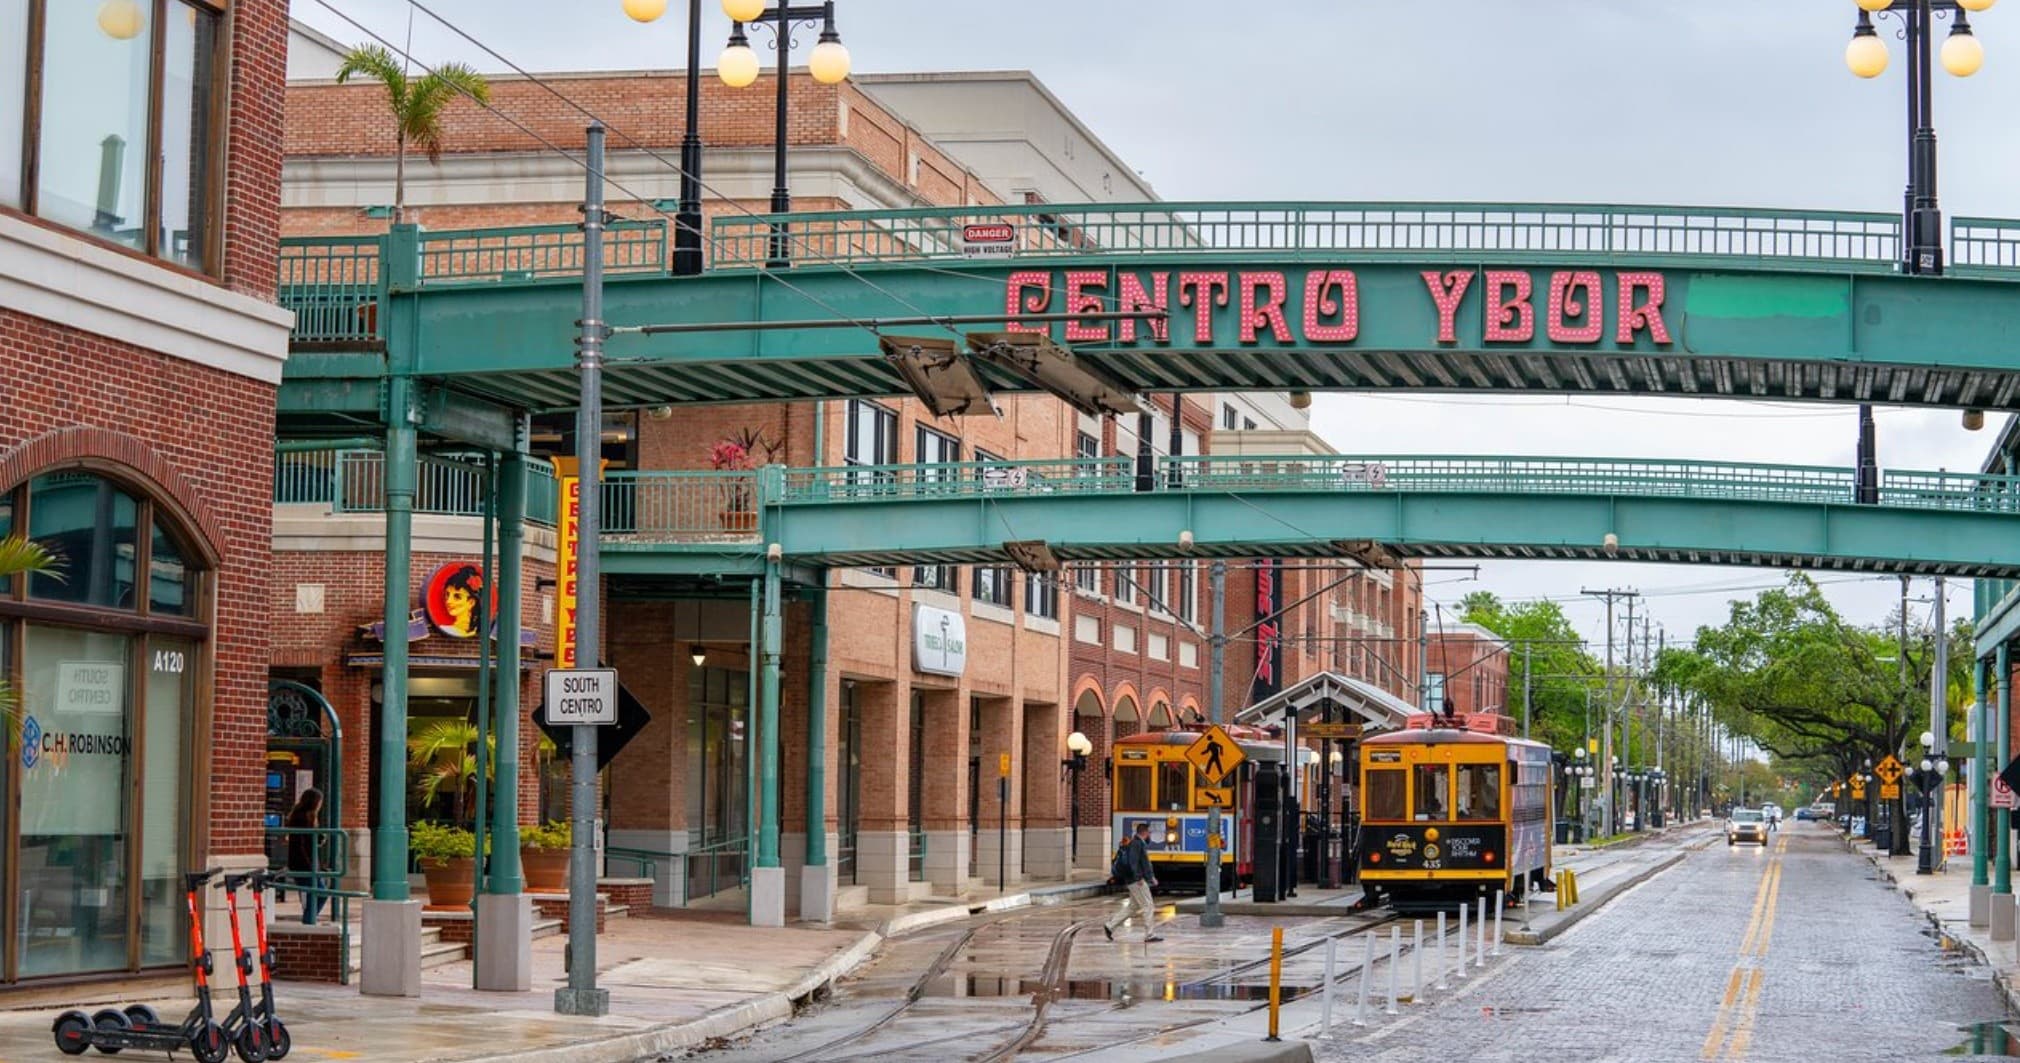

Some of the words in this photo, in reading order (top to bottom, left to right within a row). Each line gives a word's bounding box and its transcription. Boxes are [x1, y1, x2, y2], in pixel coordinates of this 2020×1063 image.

[968, 229, 1009, 238] DANGER
[983, 246, 1012, 254] VOLTAGE
[1005, 270, 1359, 343] CENTRO
[1420, 270, 1674, 344] YBOR
[153, 650, 184, 673] A120
[563, 677, 600, 693] SOUTH
[560, 698, 603, 715] CENTRO
[42, 733, 67, 752] C.H.
[69, 733, 132, 754] ROBINSON
[1421, 860, 1441, 869] 435
